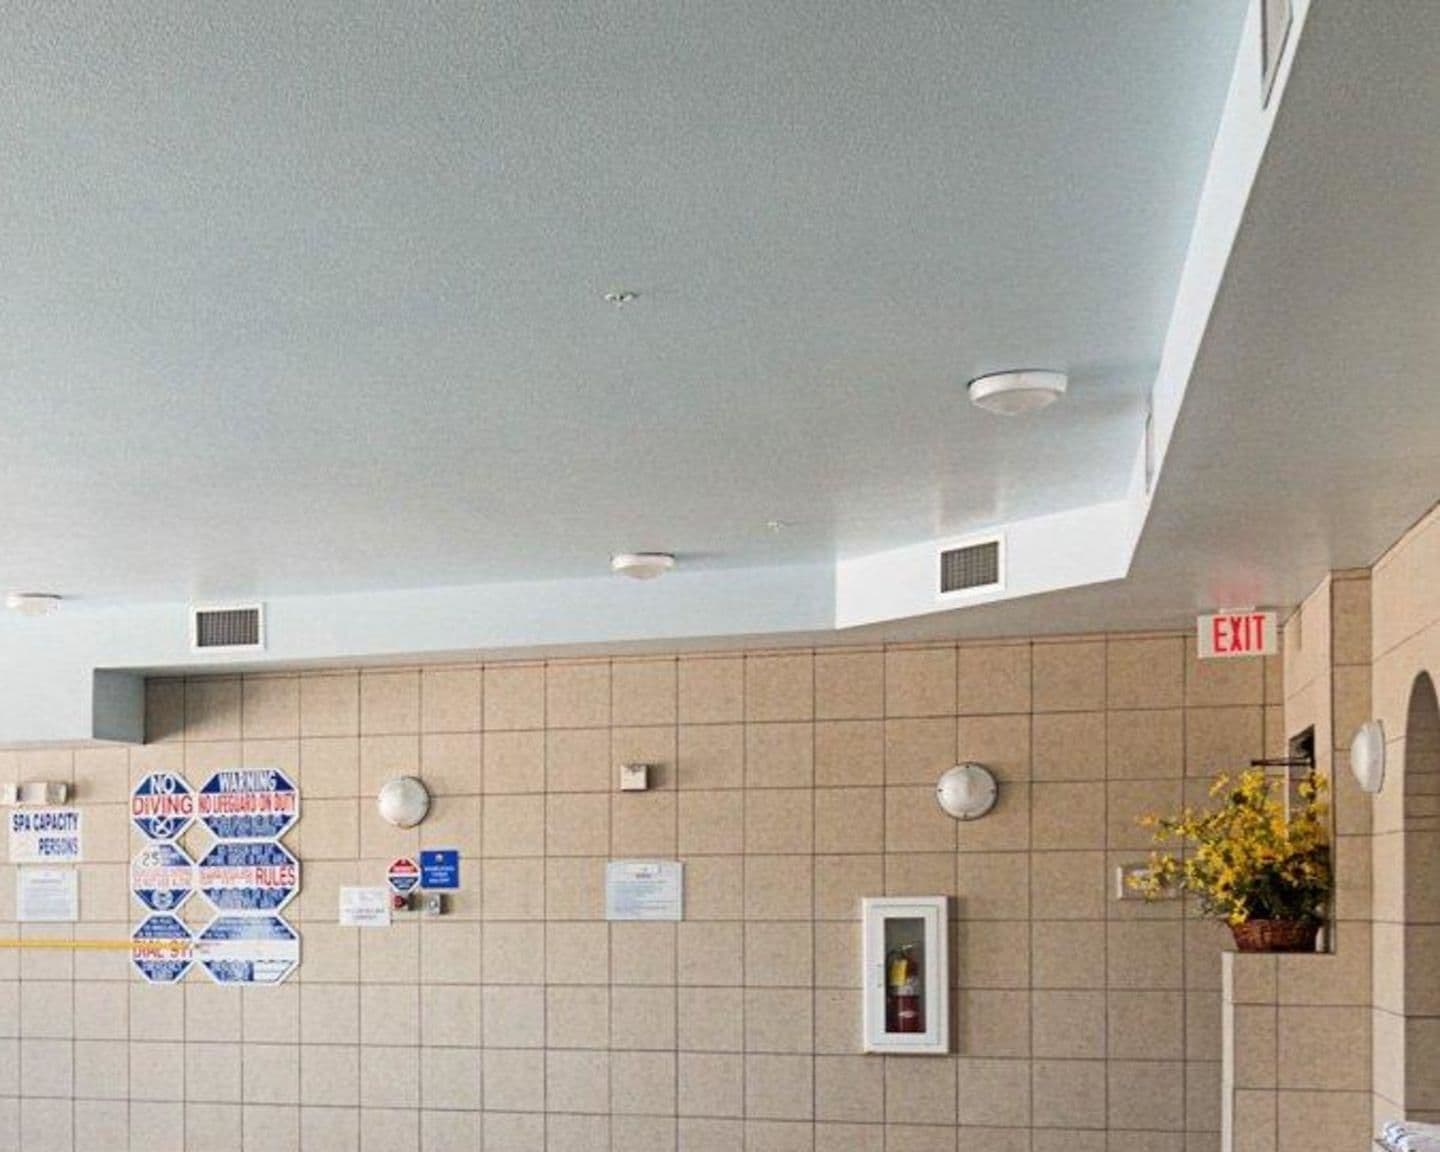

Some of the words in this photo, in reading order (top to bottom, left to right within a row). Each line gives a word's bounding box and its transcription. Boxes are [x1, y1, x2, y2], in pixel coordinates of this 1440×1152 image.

[1213, 615, 1265, 652] EXIT
[151, 774, 175, 793] NO
[219, 770, 277, 792] WARNING
[133, 795, 193, 815] DIVING
[199, 795, 210, 813] NO
[13, 813, 31, 831] SPA
[33, 812, 79, 831] CAPACITY
[255, 867, 295, 886] RULES
